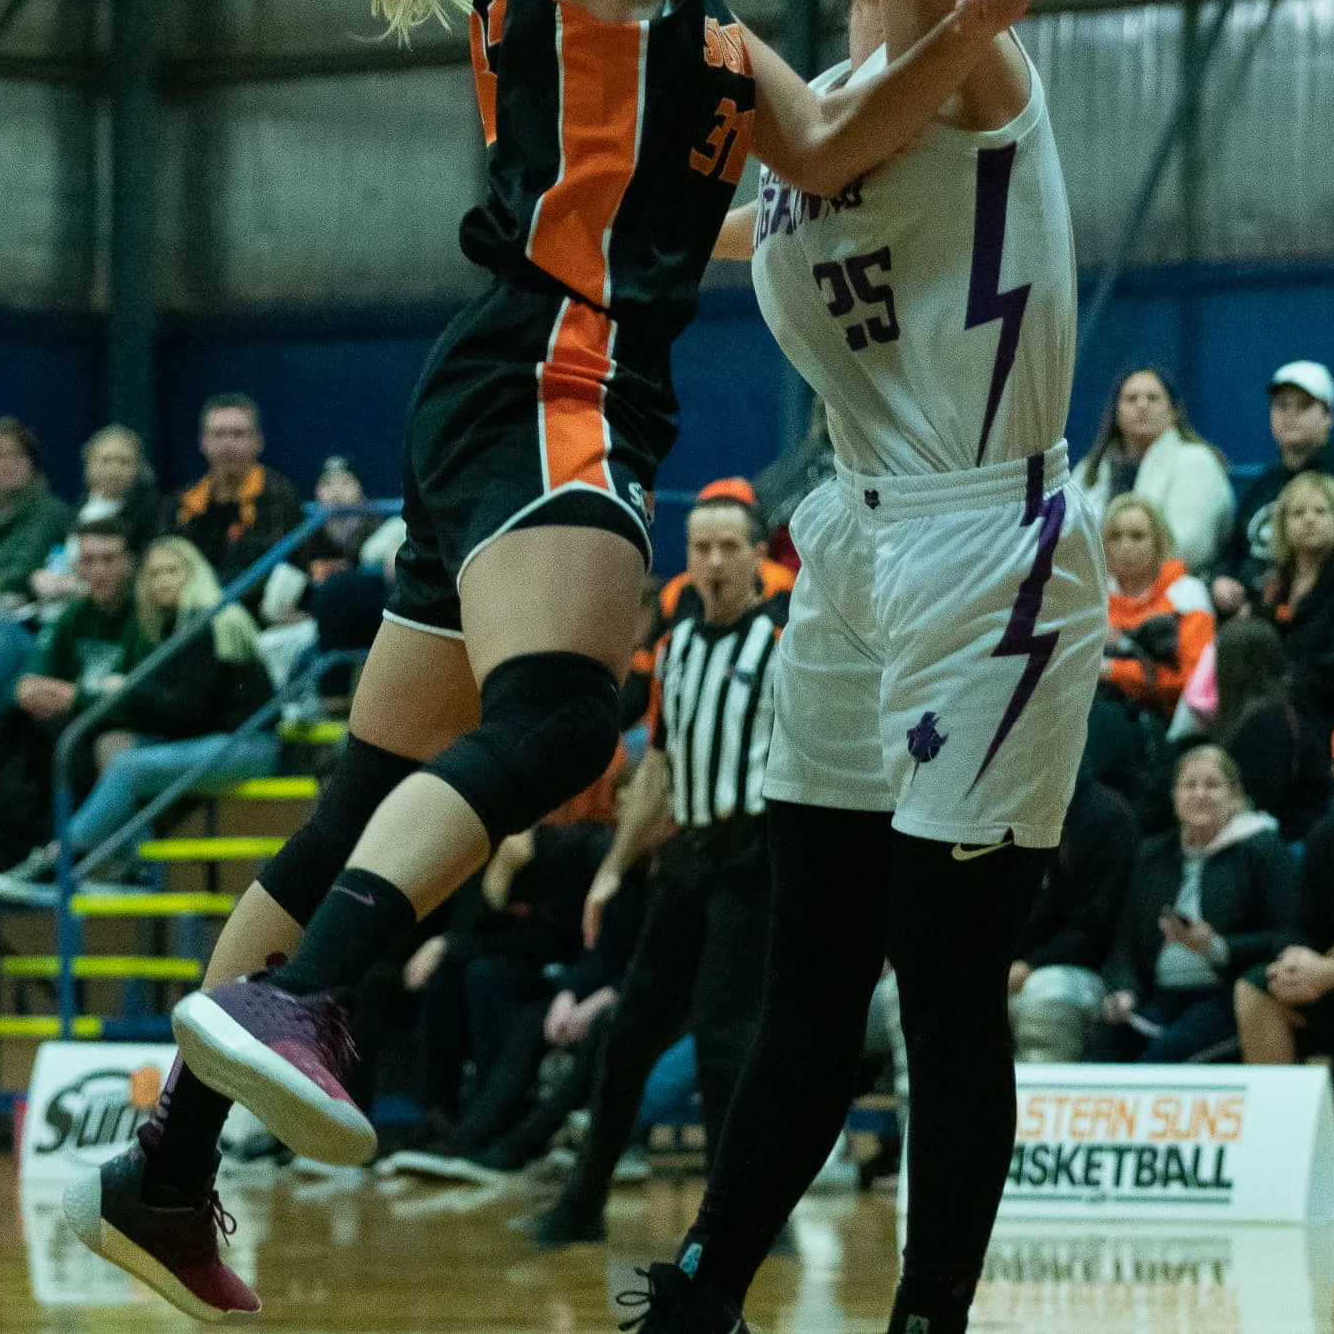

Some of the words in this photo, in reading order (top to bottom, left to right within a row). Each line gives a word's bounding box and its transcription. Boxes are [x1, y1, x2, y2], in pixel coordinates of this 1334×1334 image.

[813, 246, 900, 351] 25
[1016, 1096, 1139, 1140] STERN
[1149, 1096, 1244, 1141] SUNS
[1007, 1143, 1233, 1189] ASKETBALL
